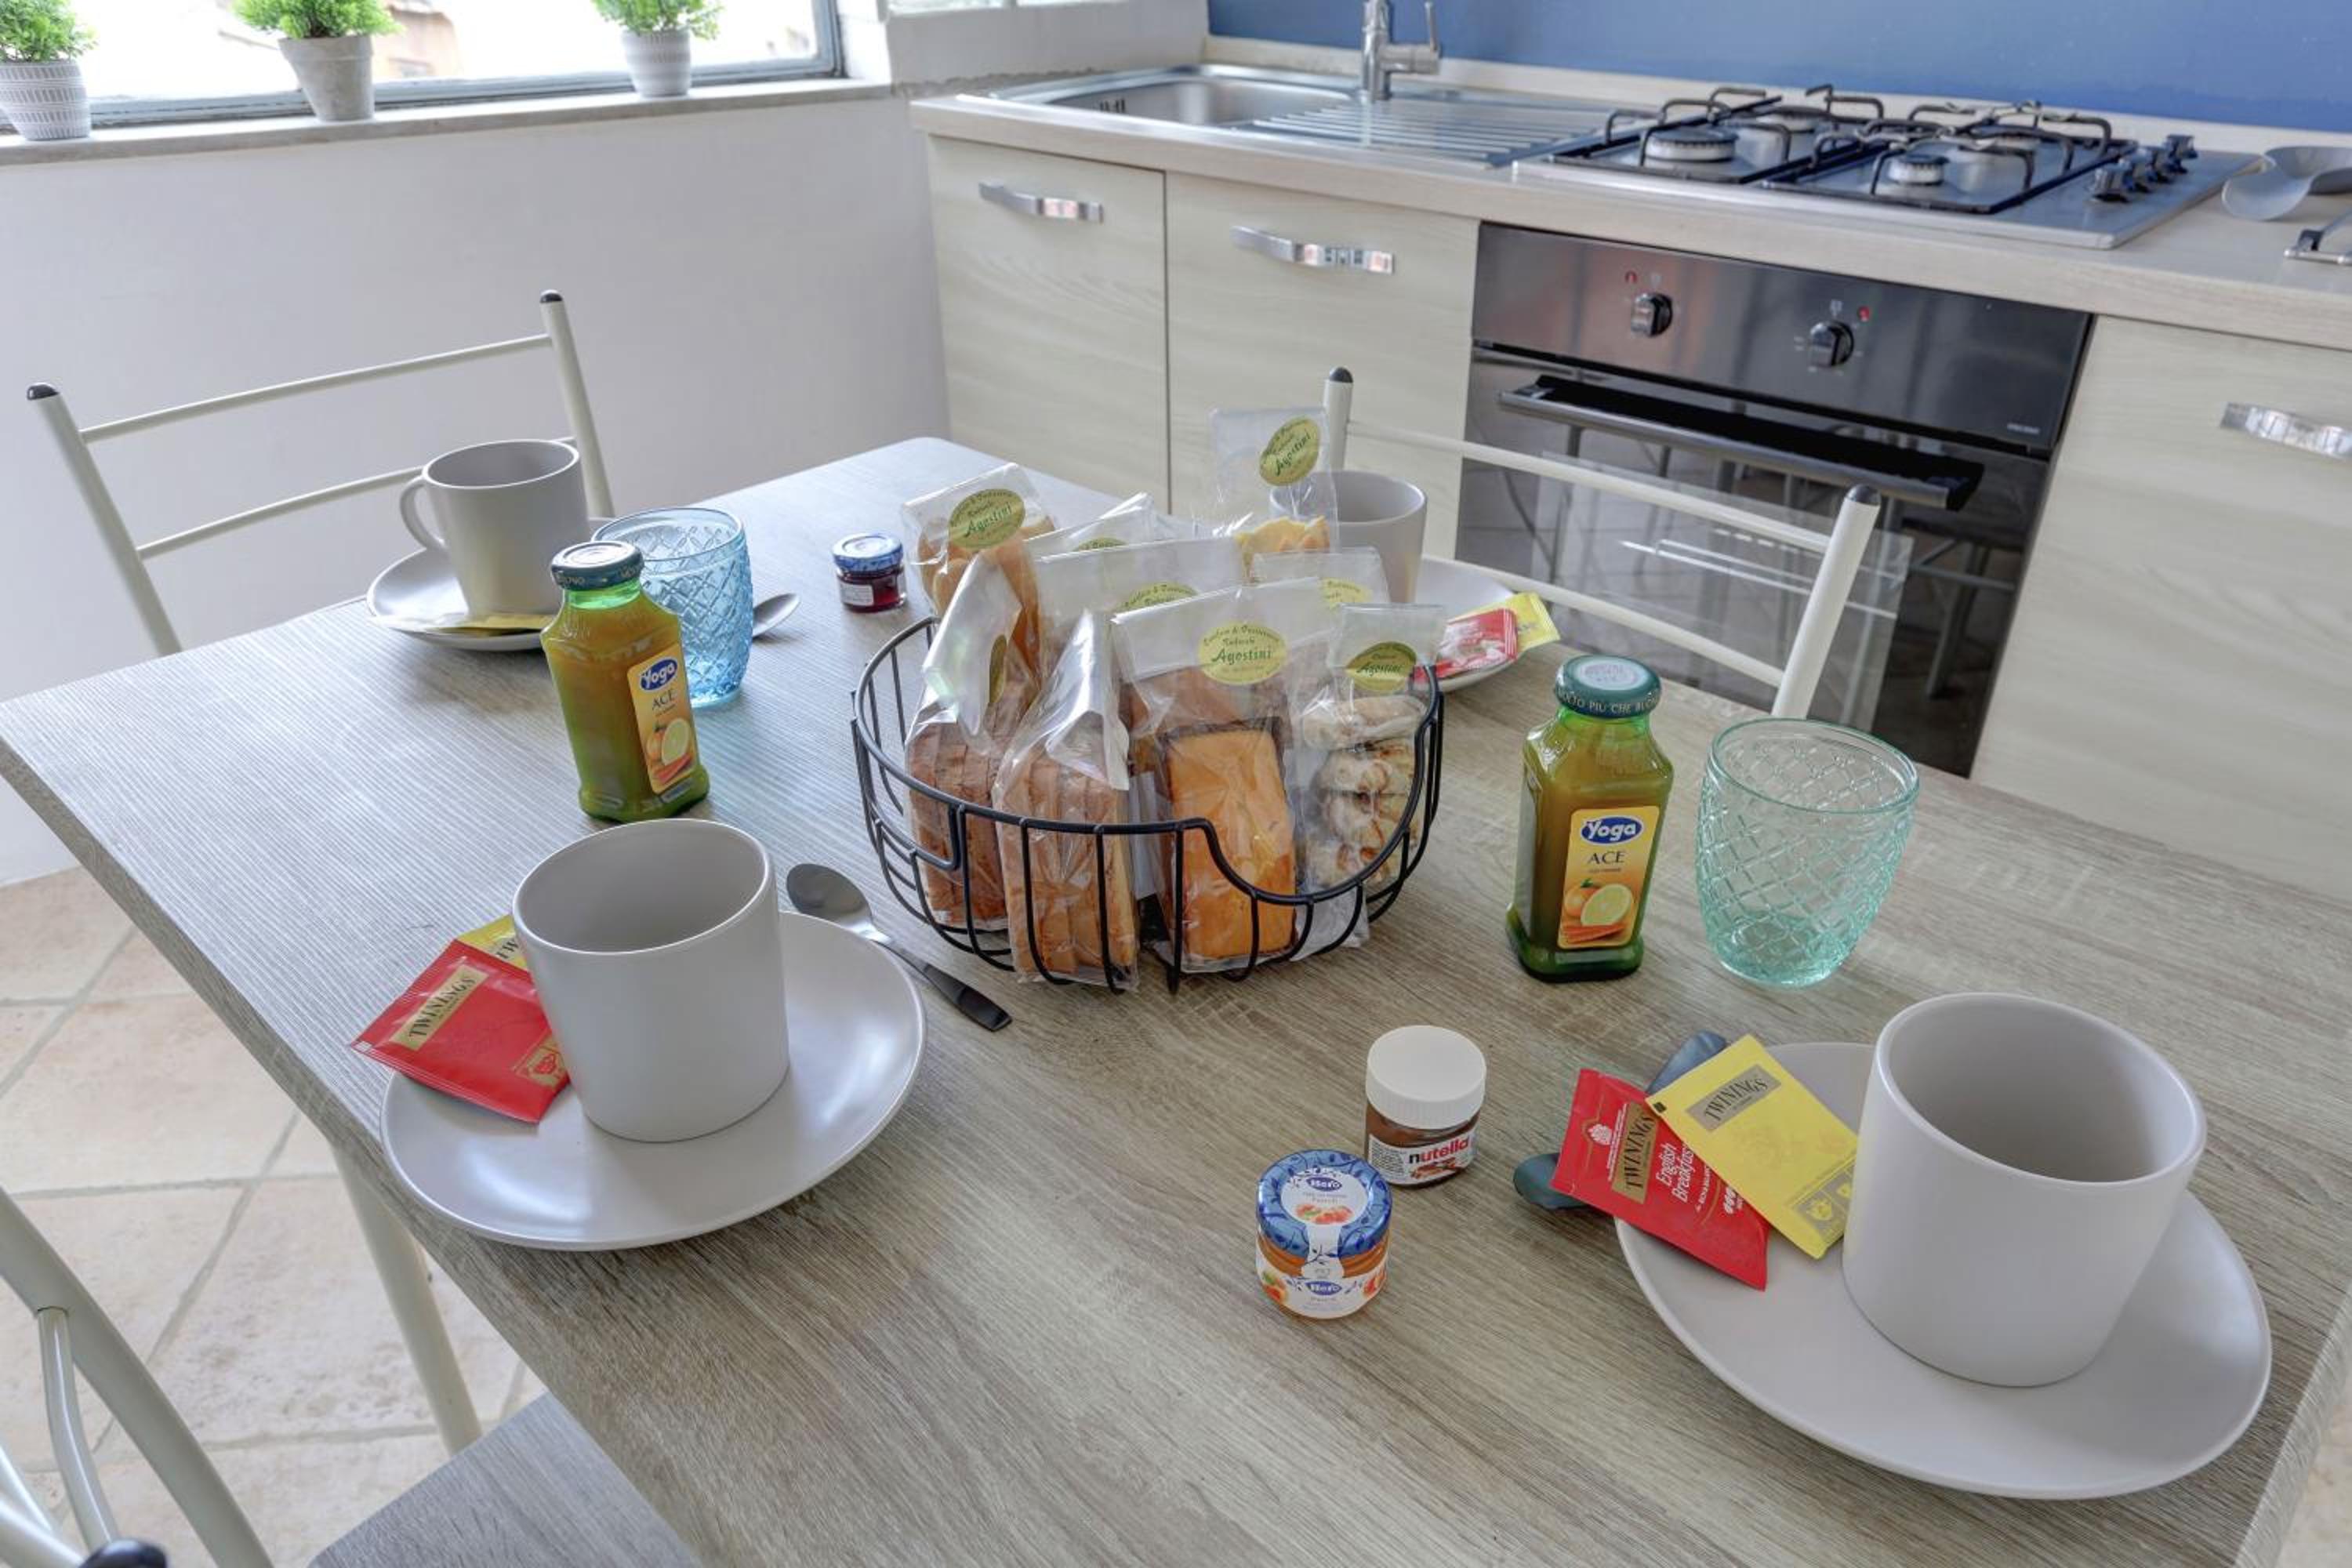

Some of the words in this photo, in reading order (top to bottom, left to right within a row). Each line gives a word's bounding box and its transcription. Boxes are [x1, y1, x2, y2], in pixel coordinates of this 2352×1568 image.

[964, 501, 1011, 538] Agostini
[1210, 648, 1272, 665] Agostini
[1356, 662, 1401, 677] Agostini
[642, 662, 675, 688] Yoga
[652, 688, 677, 710] ACE
[1585, 820, 1637, 841] Yoga
[1588, 850, 1626, 865] ACE
[408, 978, 476, 1037] TWININGS
[1704, 1078, 1769, 1121] TWININGS
[1408, 1137, 1470, 1164] nutella
[1623, 1115, 1656, 1189] TWININGS
[1656, 1142, 1677, 1186] English
